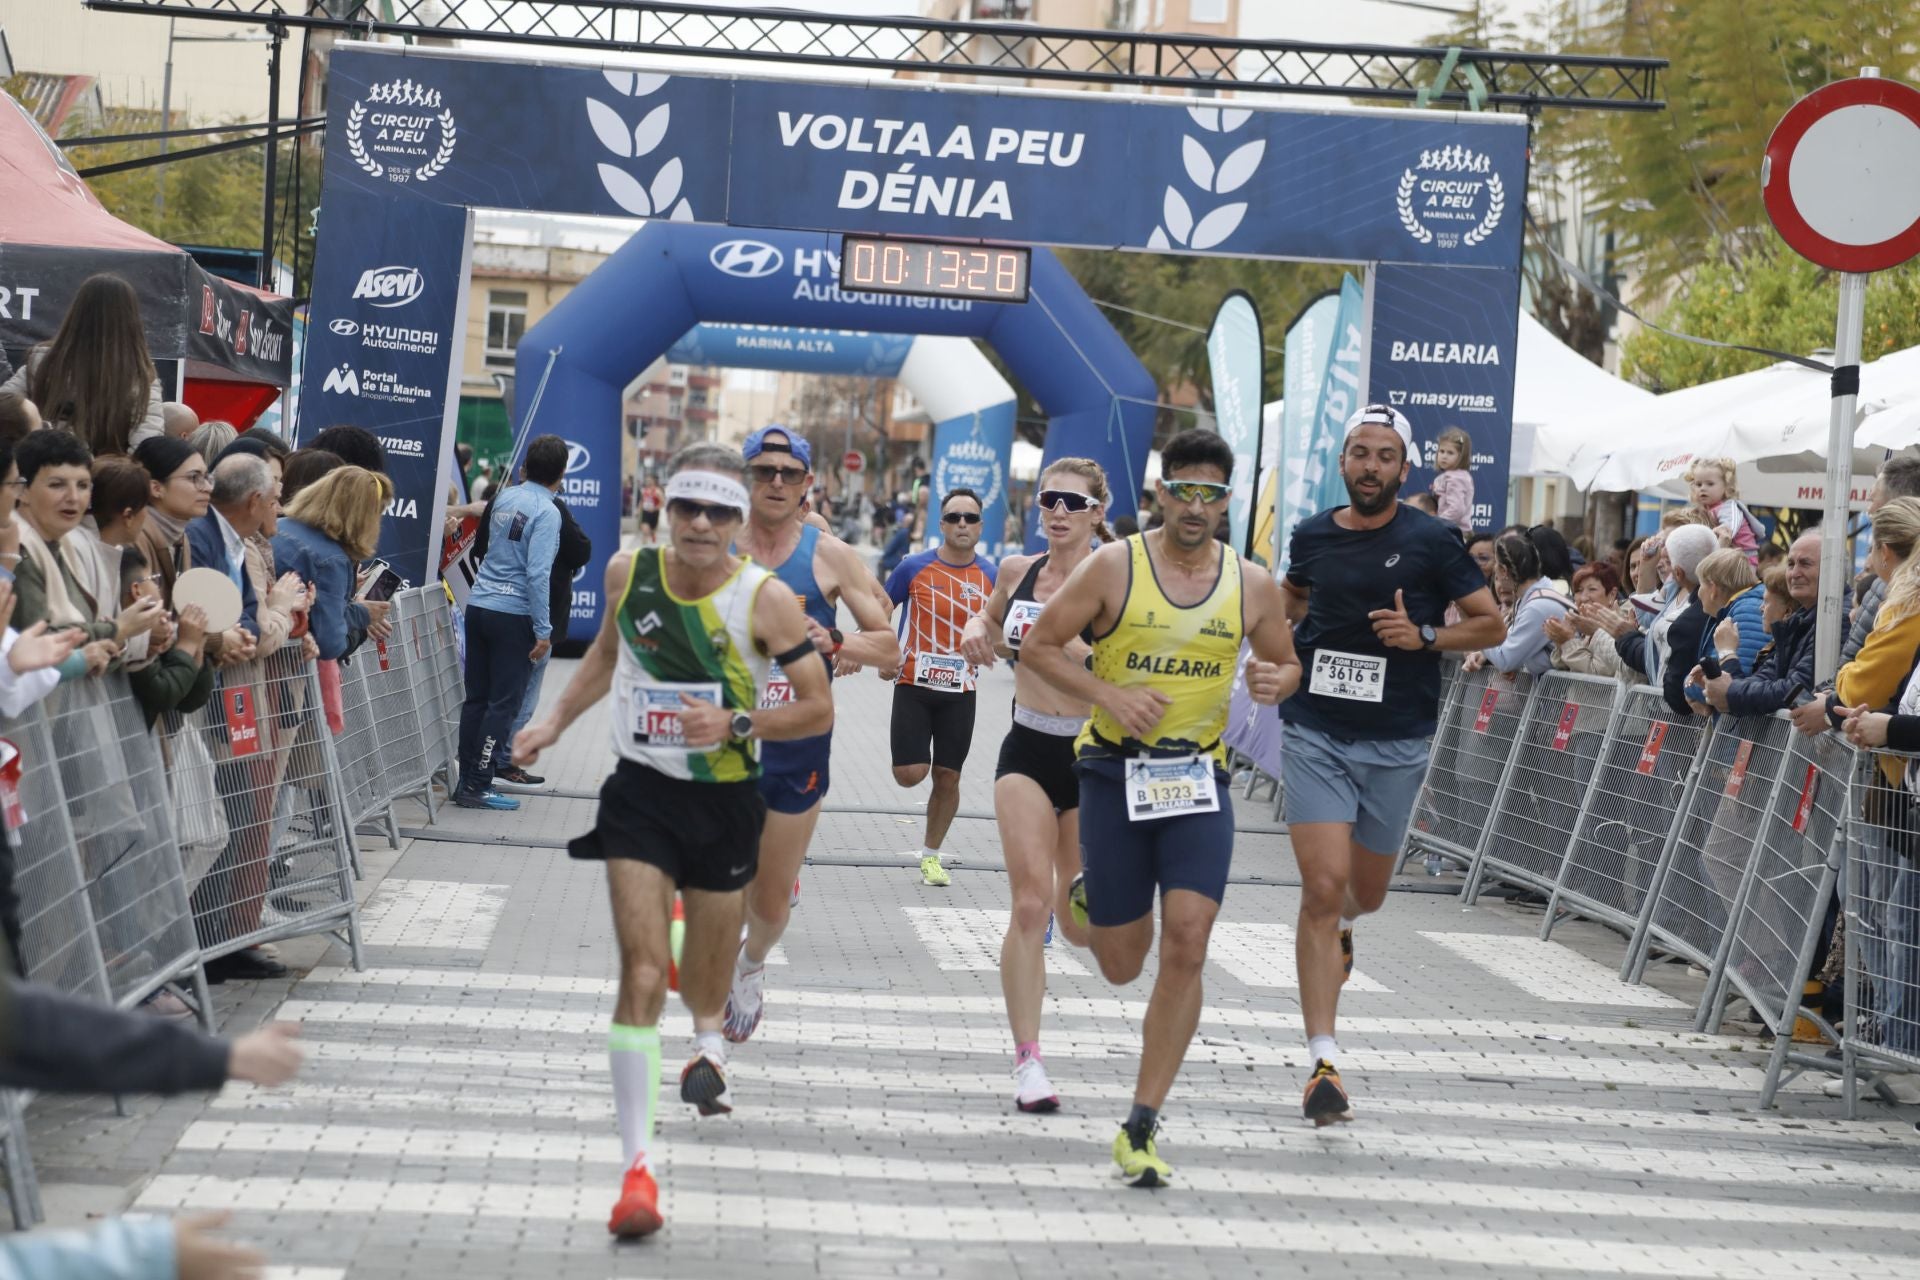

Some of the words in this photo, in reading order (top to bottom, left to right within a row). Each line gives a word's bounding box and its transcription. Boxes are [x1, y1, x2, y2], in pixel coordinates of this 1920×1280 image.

[370, 113, 434, 129] CIRCUIT
[376, 128, 388, 140] A
[393, 130, 425, 143] PEU
[778, 112, 931, 157] VOLTA
[936, 125, 975, 160] A
[985, 127, 1085, 167] PEU
[374, 145, 405, 154] MARINA
[407, 147, 427, 155] ALTA
[389, 174, 410, 183] 1997
[837, 163, 1012, 220] DÉNIA
[1420, 180, 1483, 194] CIRCUIT
[1426, 194, 1437, 207] A
[1442, 195, 1474, 208] PEU
[1423, 211, 1453, 219] MARINA
[1455, 212, 1476, 220] ALTA
[1437, 240, 1458, 248] 1997
[854, 244, 1017, 292] 00:13:28
[362, 324, 438, 345] HYUNDAI
[362, 336, 437, 354] Autoalmenar
[736, 336, 792, 350] MARINA
[797, 340, 835, 353] ALTA
[363, 369, 397, 383] Portal
[362, 380, 376, 391] de
[379, 382, 390, 392] la
[393, 384, 431, 397] Marina
[1410, 392, 1494, 408] masymas
[1011, 625, 1019, 637] A
[1335, 657, 1351, 666] SOM
[1352, 660, 1378, 669] ESPORT
[930, 669, 953, 681] 1409
[1329, 666, 1363, 682] 3616
[1137, 790, 1146, 801] B
[1152, 786, 1191, 800] 1323
